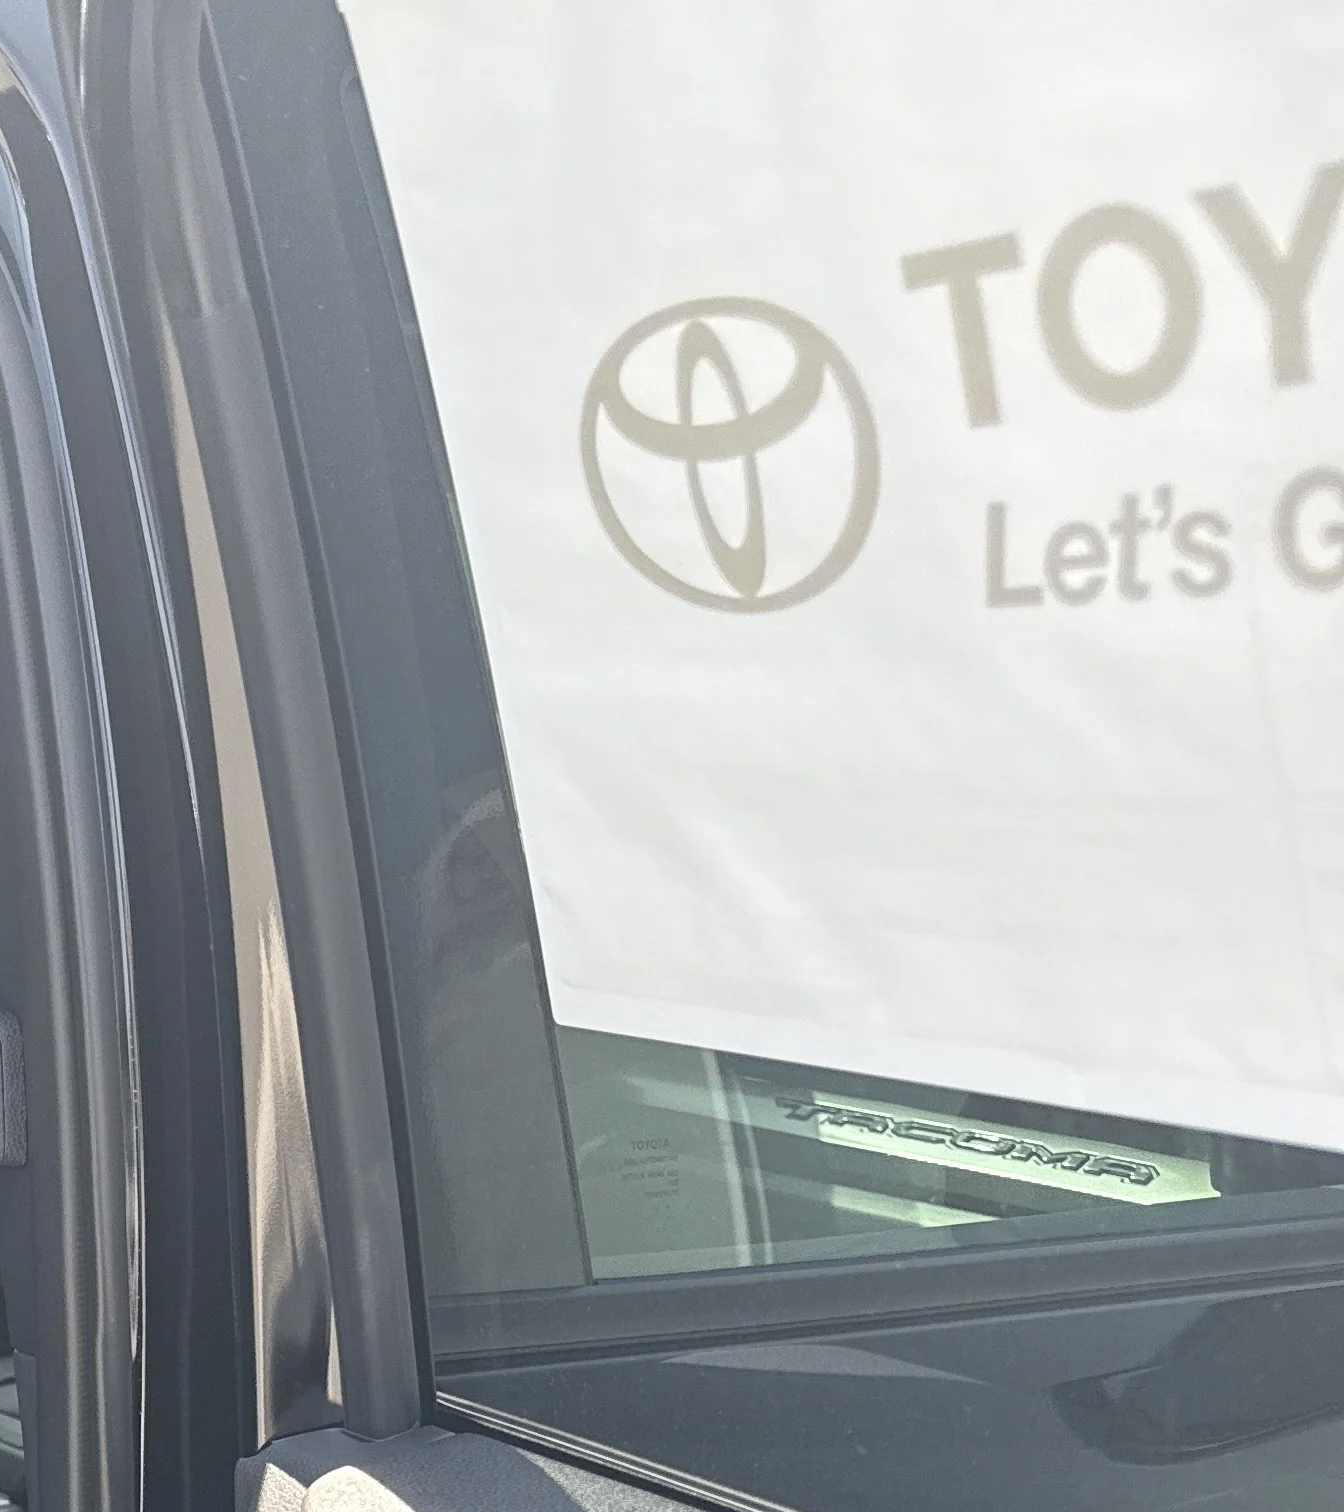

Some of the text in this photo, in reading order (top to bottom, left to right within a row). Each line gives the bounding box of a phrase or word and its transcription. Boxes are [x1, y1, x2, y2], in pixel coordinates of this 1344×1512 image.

[900, 157, 1344, 430] TOY
[985, 484, 1235, 609] Let's
[631, 1138, 672, 1151] TOYOTA
[775, 1096, 1161, 1186] TACOMA
